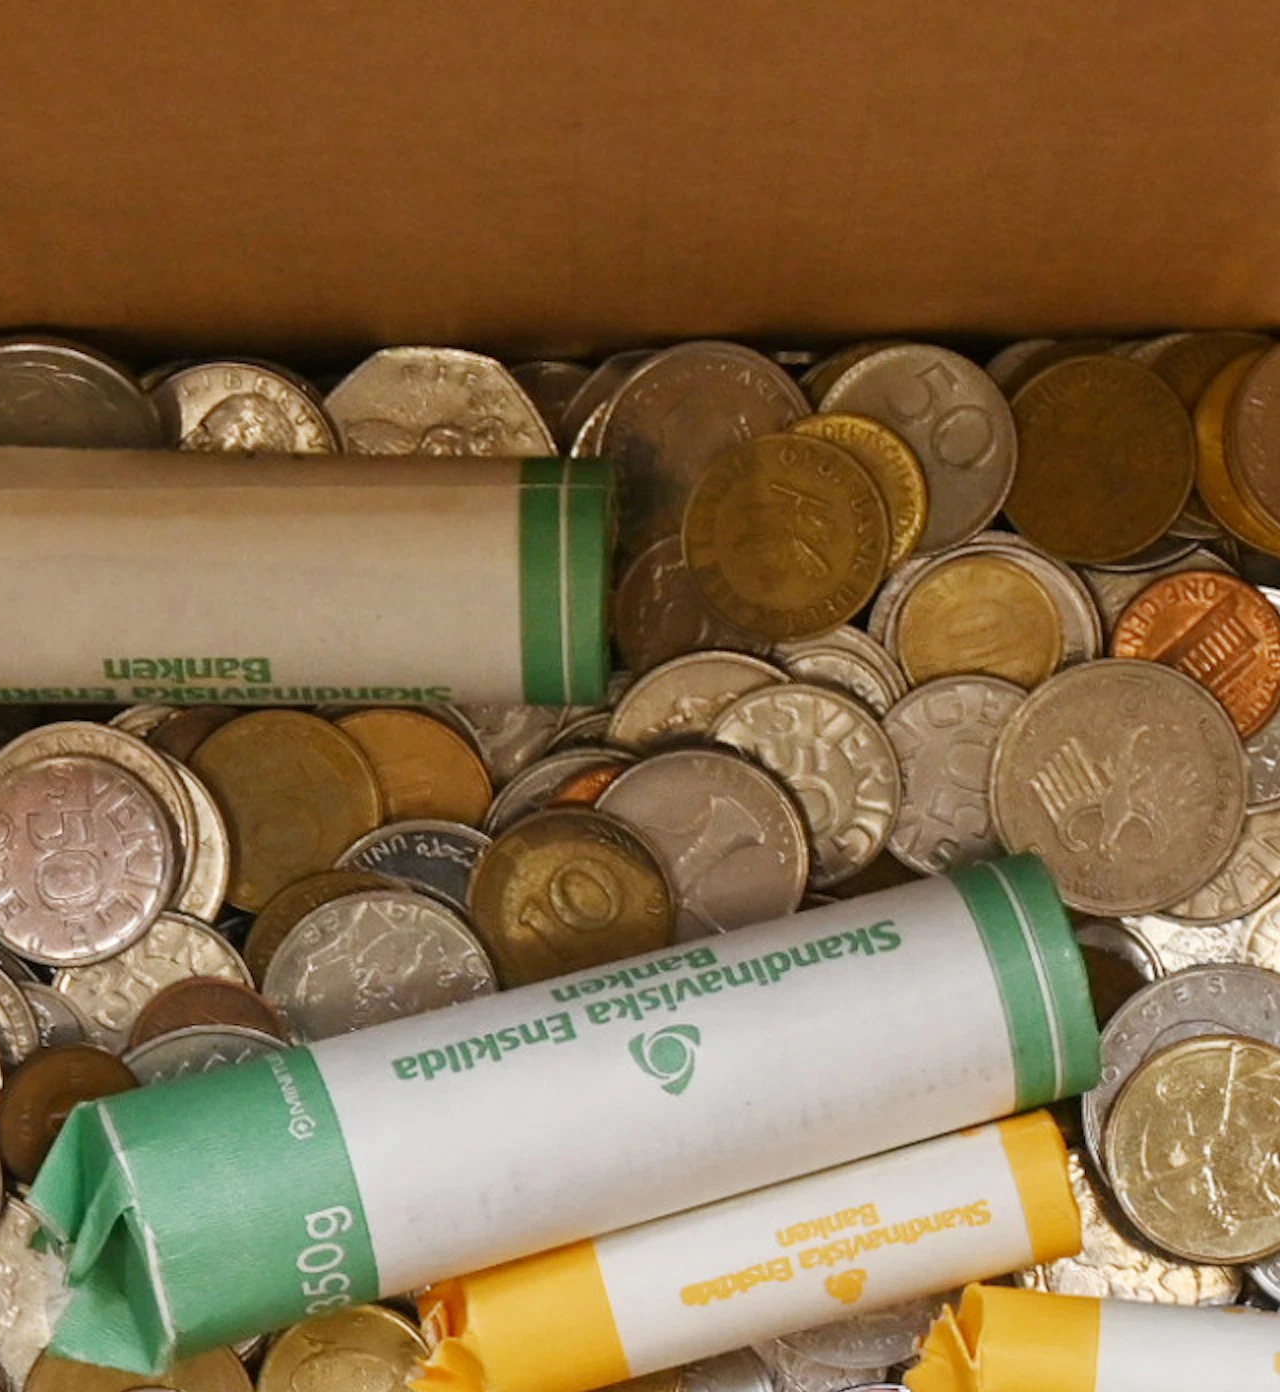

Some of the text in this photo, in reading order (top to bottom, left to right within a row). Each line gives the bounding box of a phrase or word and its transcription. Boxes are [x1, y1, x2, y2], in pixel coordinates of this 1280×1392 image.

[102, 656, 272, 684] Banken
[390, 916, 905, 1087] Skandinaviska Enskilda
[549, 943, 719, 1005] Banken
[774, 1201, 881, 1247] Banken
[799, 1198, 993, 1273] Skandinaviska
